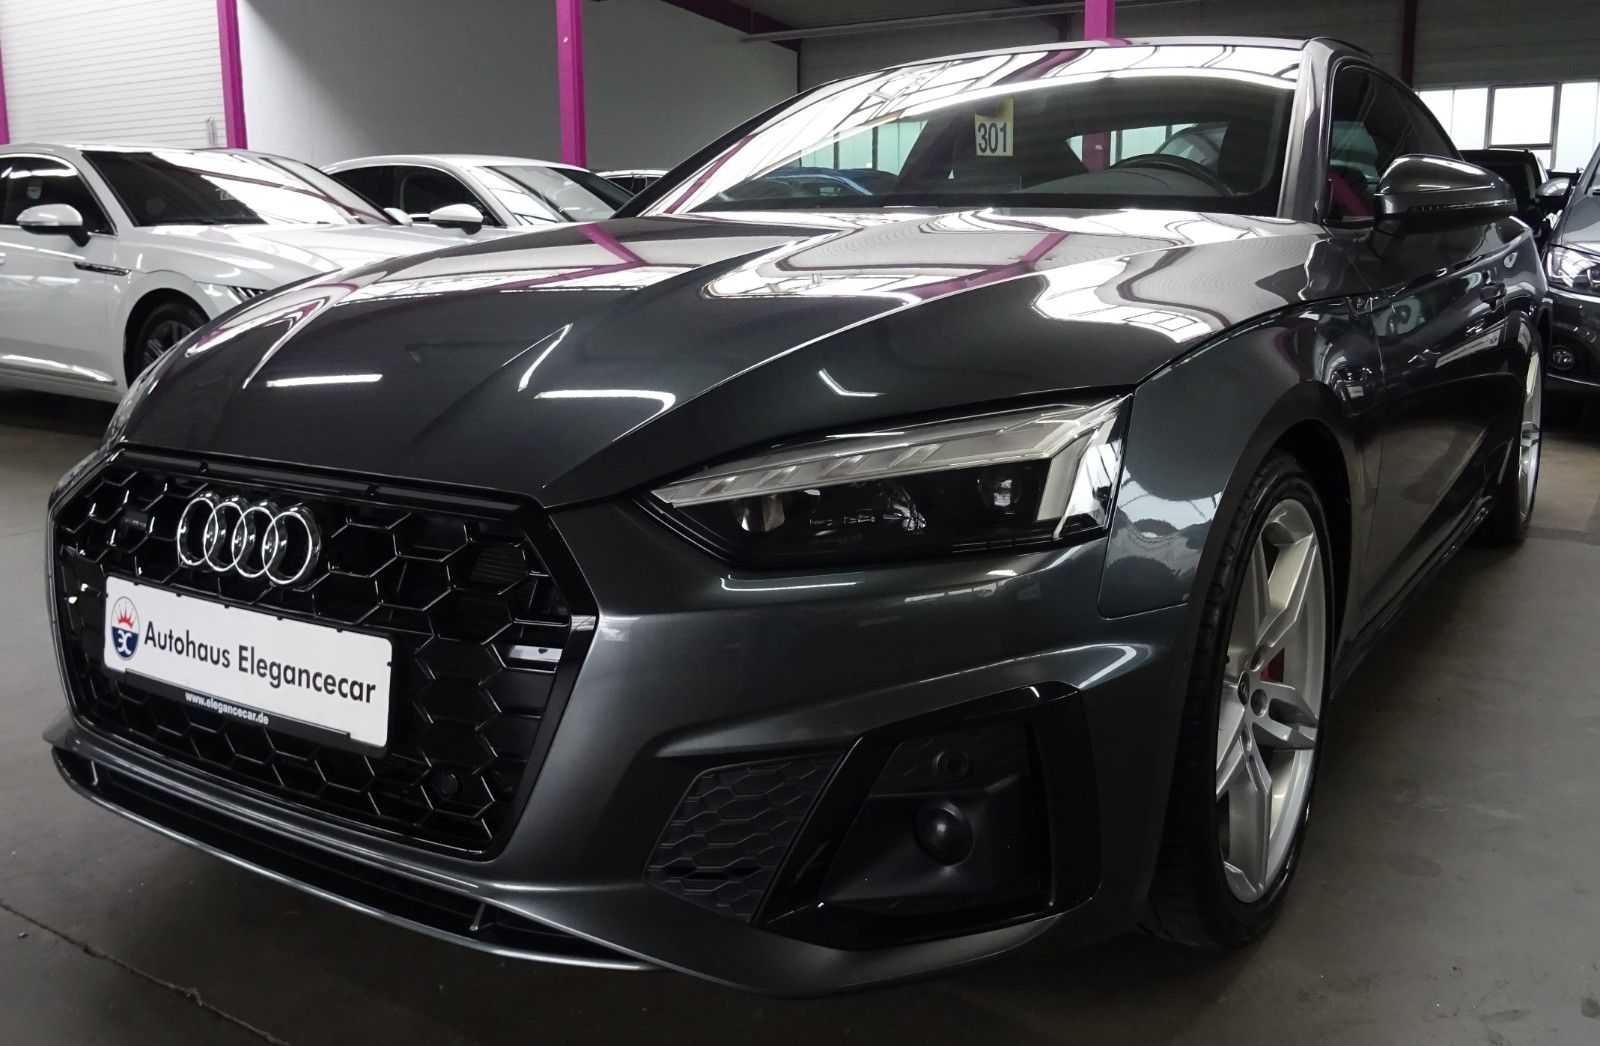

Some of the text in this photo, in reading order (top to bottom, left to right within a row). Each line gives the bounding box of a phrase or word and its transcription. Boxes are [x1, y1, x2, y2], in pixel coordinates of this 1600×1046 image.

[977, 122, 1008, 154] 301
[144, 620, 376, 704] Autohaus Elegancecar
[184, 691, 269, 725] www.elegancecar.de
